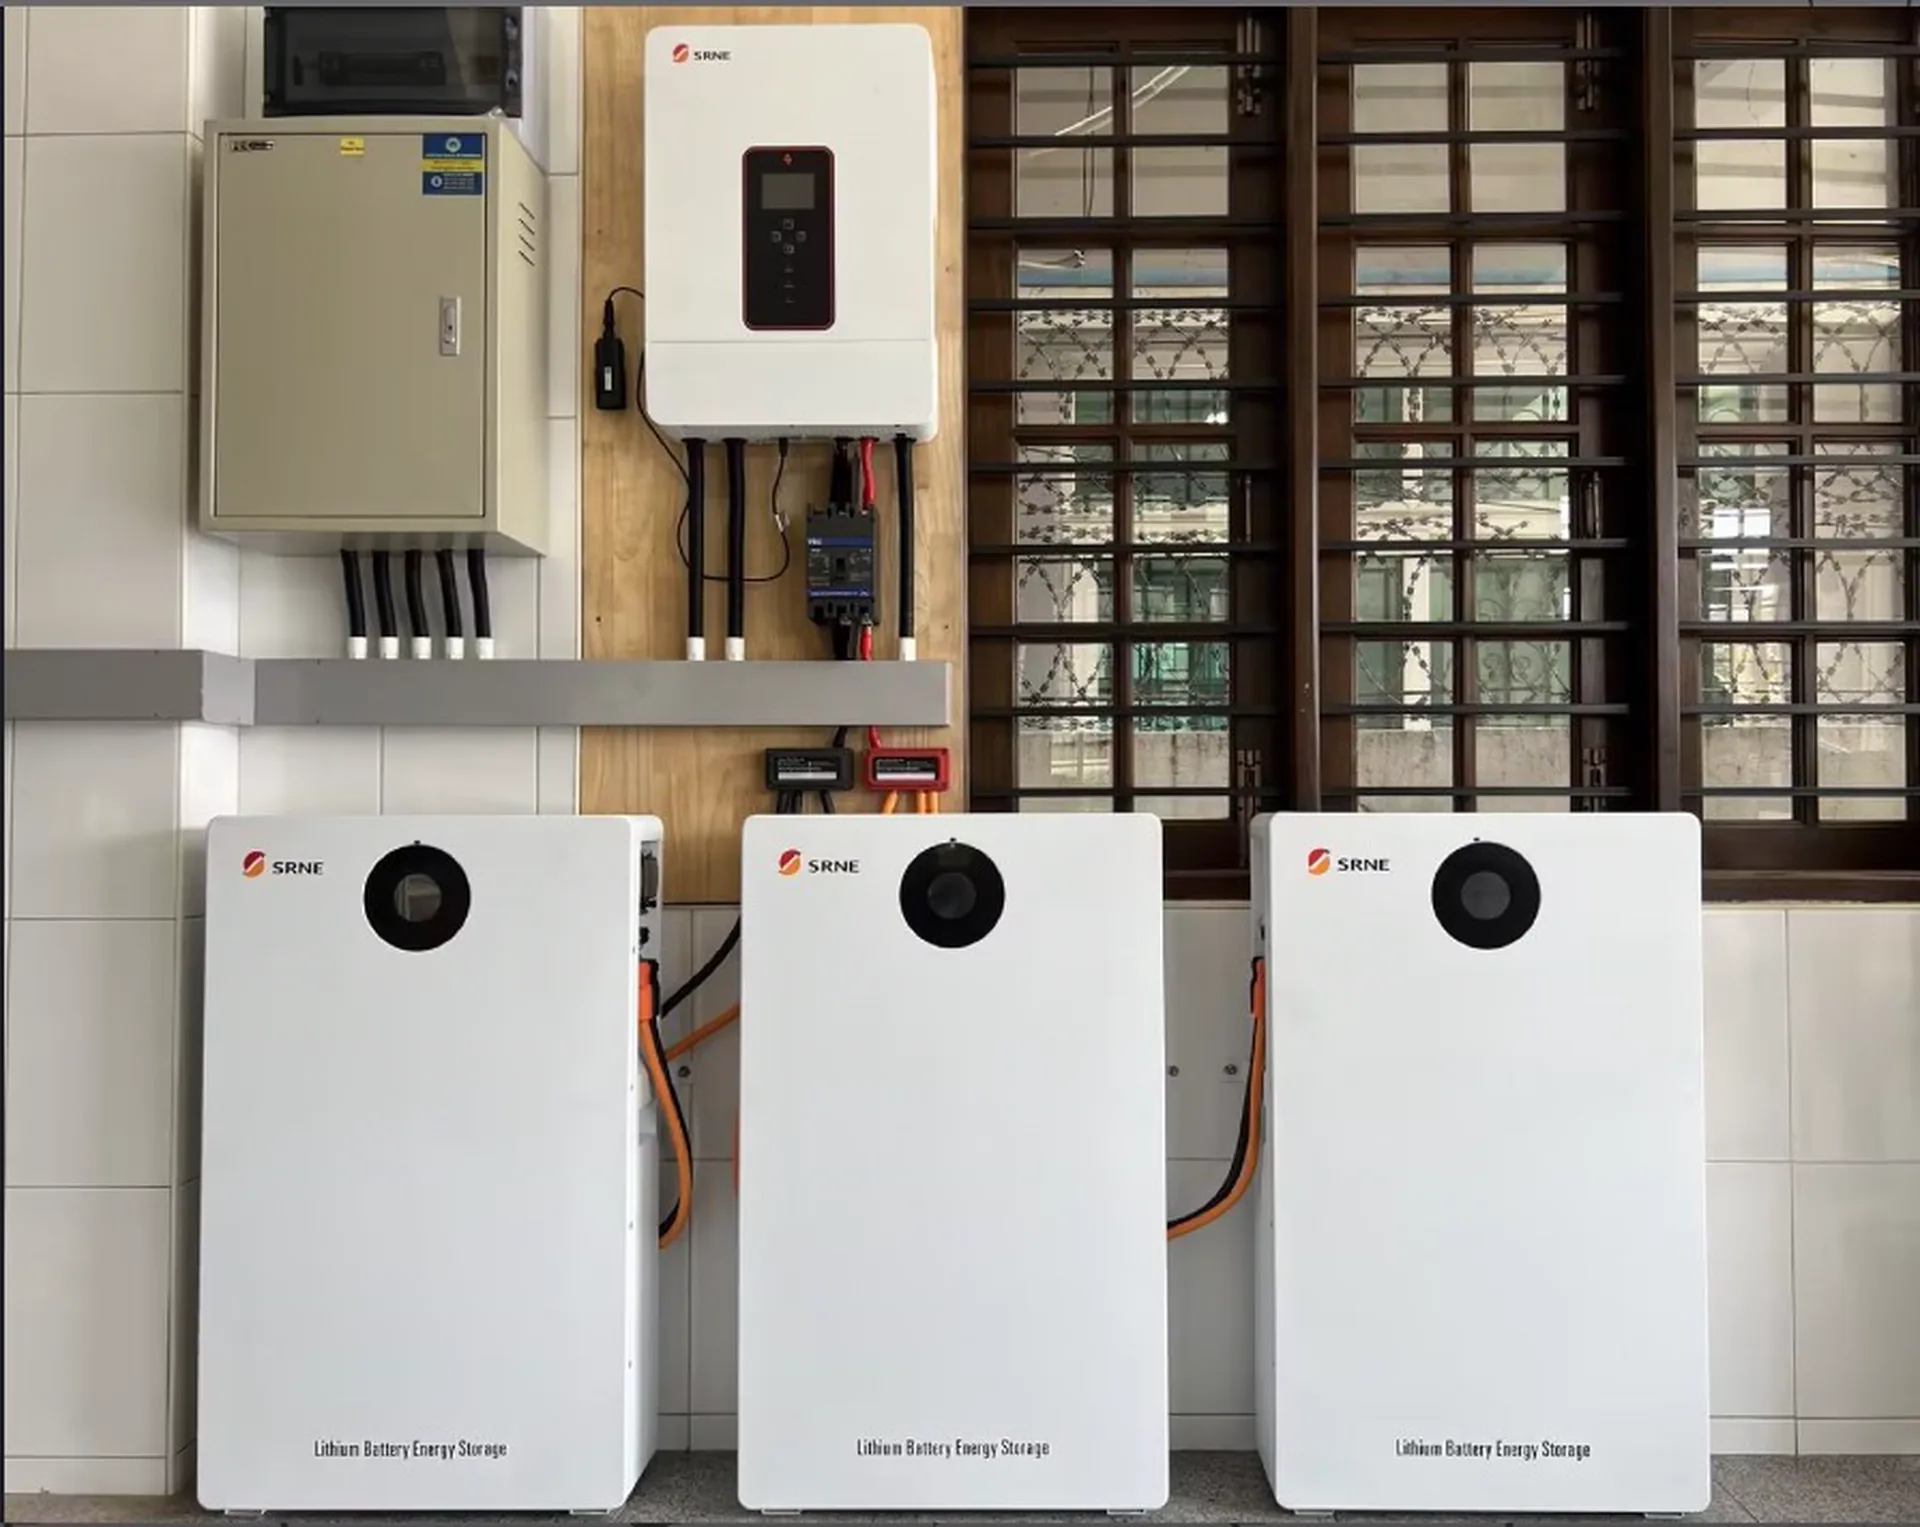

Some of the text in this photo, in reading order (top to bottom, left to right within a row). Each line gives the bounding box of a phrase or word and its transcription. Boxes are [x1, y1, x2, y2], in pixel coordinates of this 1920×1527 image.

[693, 50, 732, 61] SRNE
[271, 860, 324, 875] SRNE
[807, 859, 860, 874] SRNE
[1337, 857, 1391, 872] SRNE
[314, 1439, 508, 1461] Lithium Battery Energy Storage
[856, 1438, 1050, 1460] Lithium Battery Energy Storage
[1395, 1438, 1591, 1460] Lithium Battery Energy Storage
